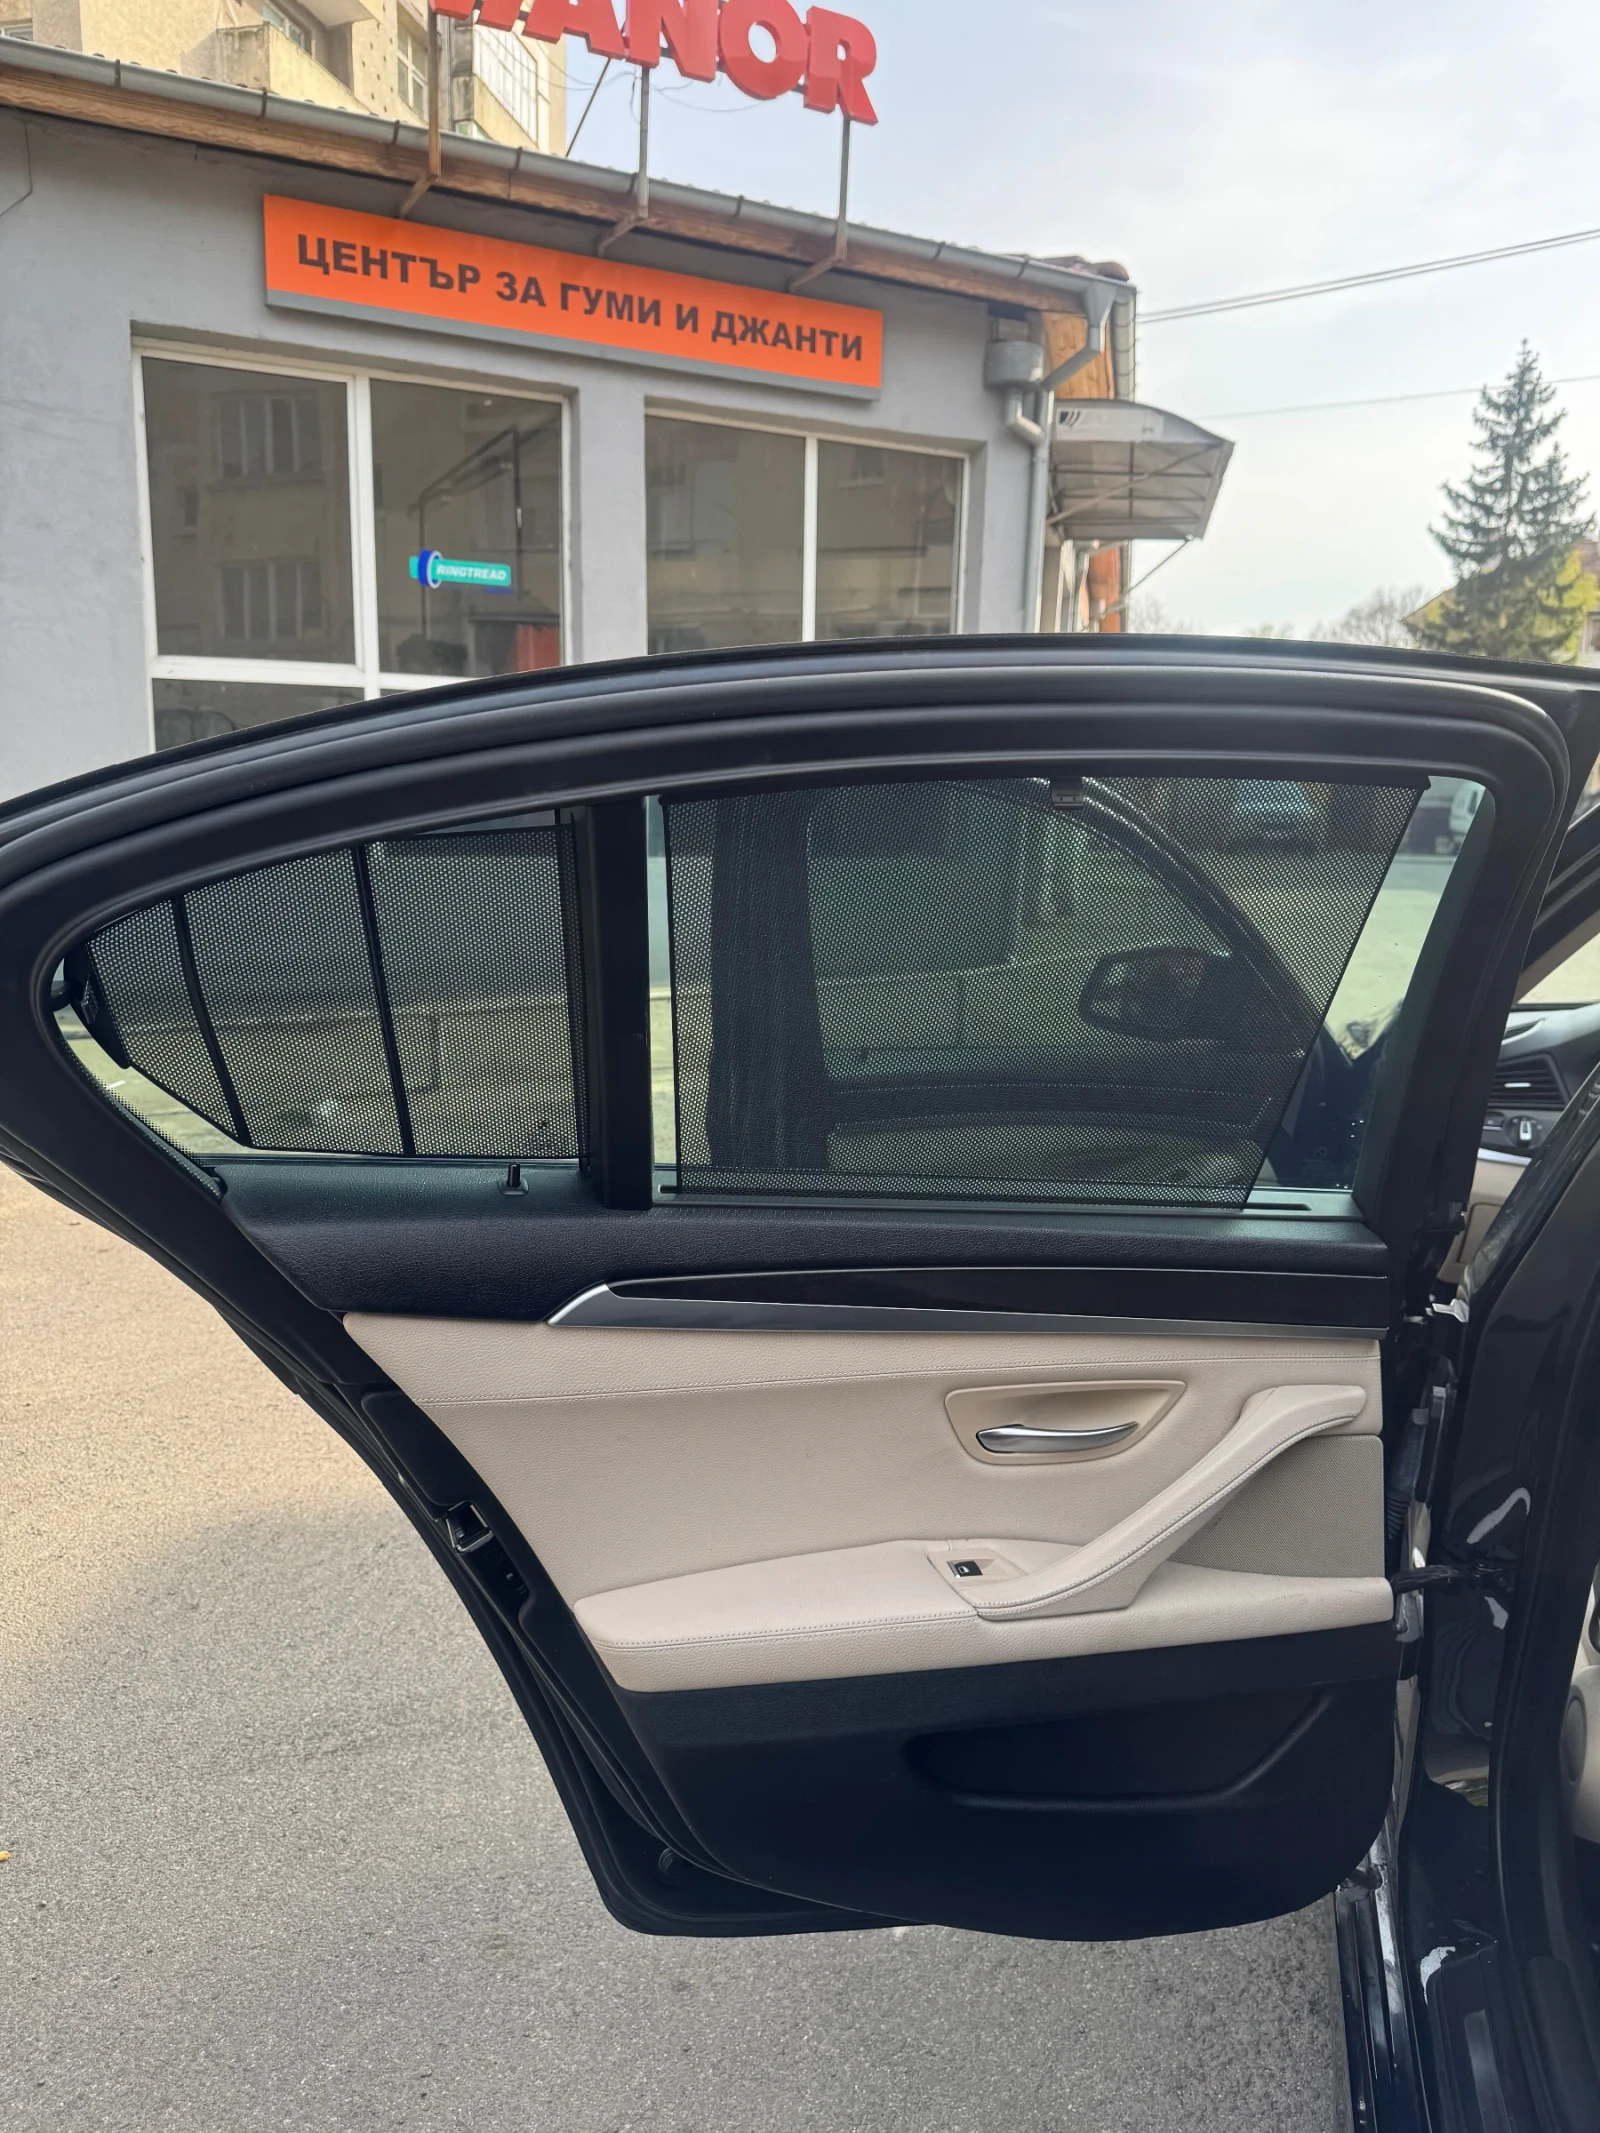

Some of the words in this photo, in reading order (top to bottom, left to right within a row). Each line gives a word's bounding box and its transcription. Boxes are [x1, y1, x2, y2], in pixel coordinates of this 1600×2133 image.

[297, 233, 481, 294] ЦЕНТЪР
[496, 271, 546, 307] ЗА
[560, 282, 661, 327] ГУМИ
[675, 303, 699, 334] И
[711, 310, 863, 361] ДЖАНТИ
[436, 564, 507, 581] RINGTREAD
